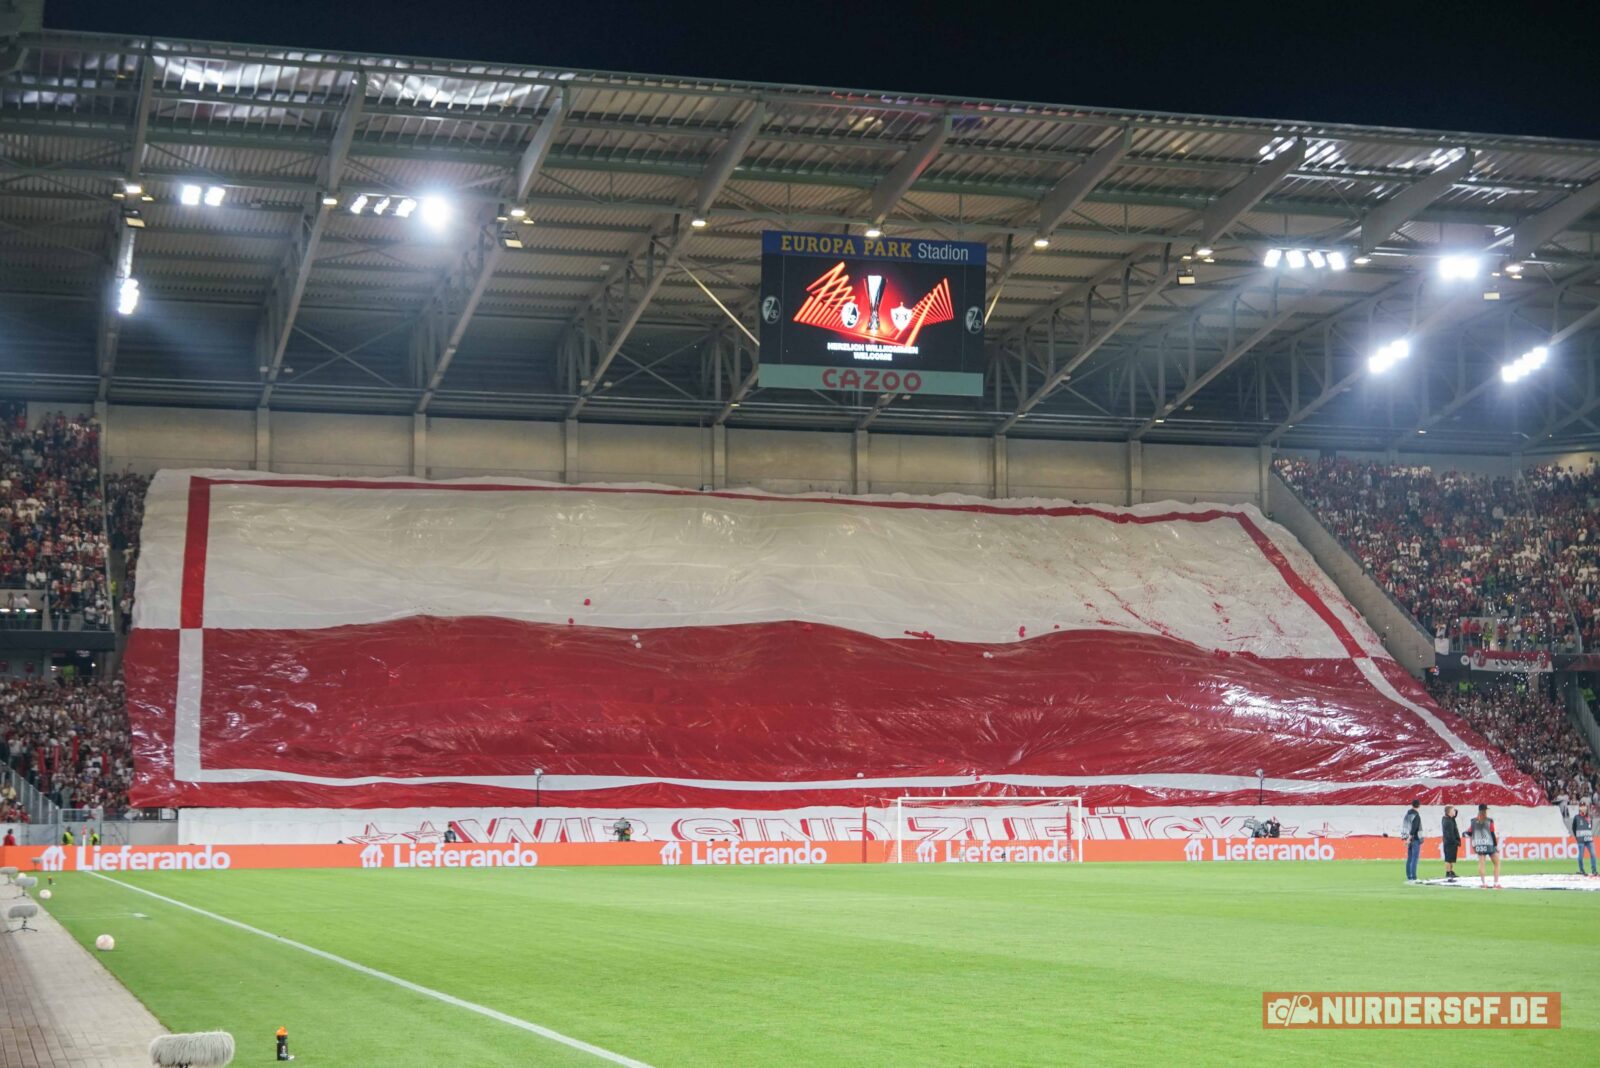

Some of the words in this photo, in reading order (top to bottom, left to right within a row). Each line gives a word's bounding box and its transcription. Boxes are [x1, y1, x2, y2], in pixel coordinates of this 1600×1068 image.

[781, 235, 856, 255] EUROPA
[863, 239, 912, 258] PARK
[918, 242, 968, 261] Stadion
[853, 351, 892, 361] WELCOME
[822, 368, 922, 392] CAZOO
[76, 844, 231, 871] Lieferando
[394, 843, 538, 867] Lieferando
[691, 841, 827, 865] Lieferando
[946, 839, 1075, 863] Lieferando
[1213, 837, 1335, 861] Lieferando
[1466, 836, 1580, 860] Lferando
